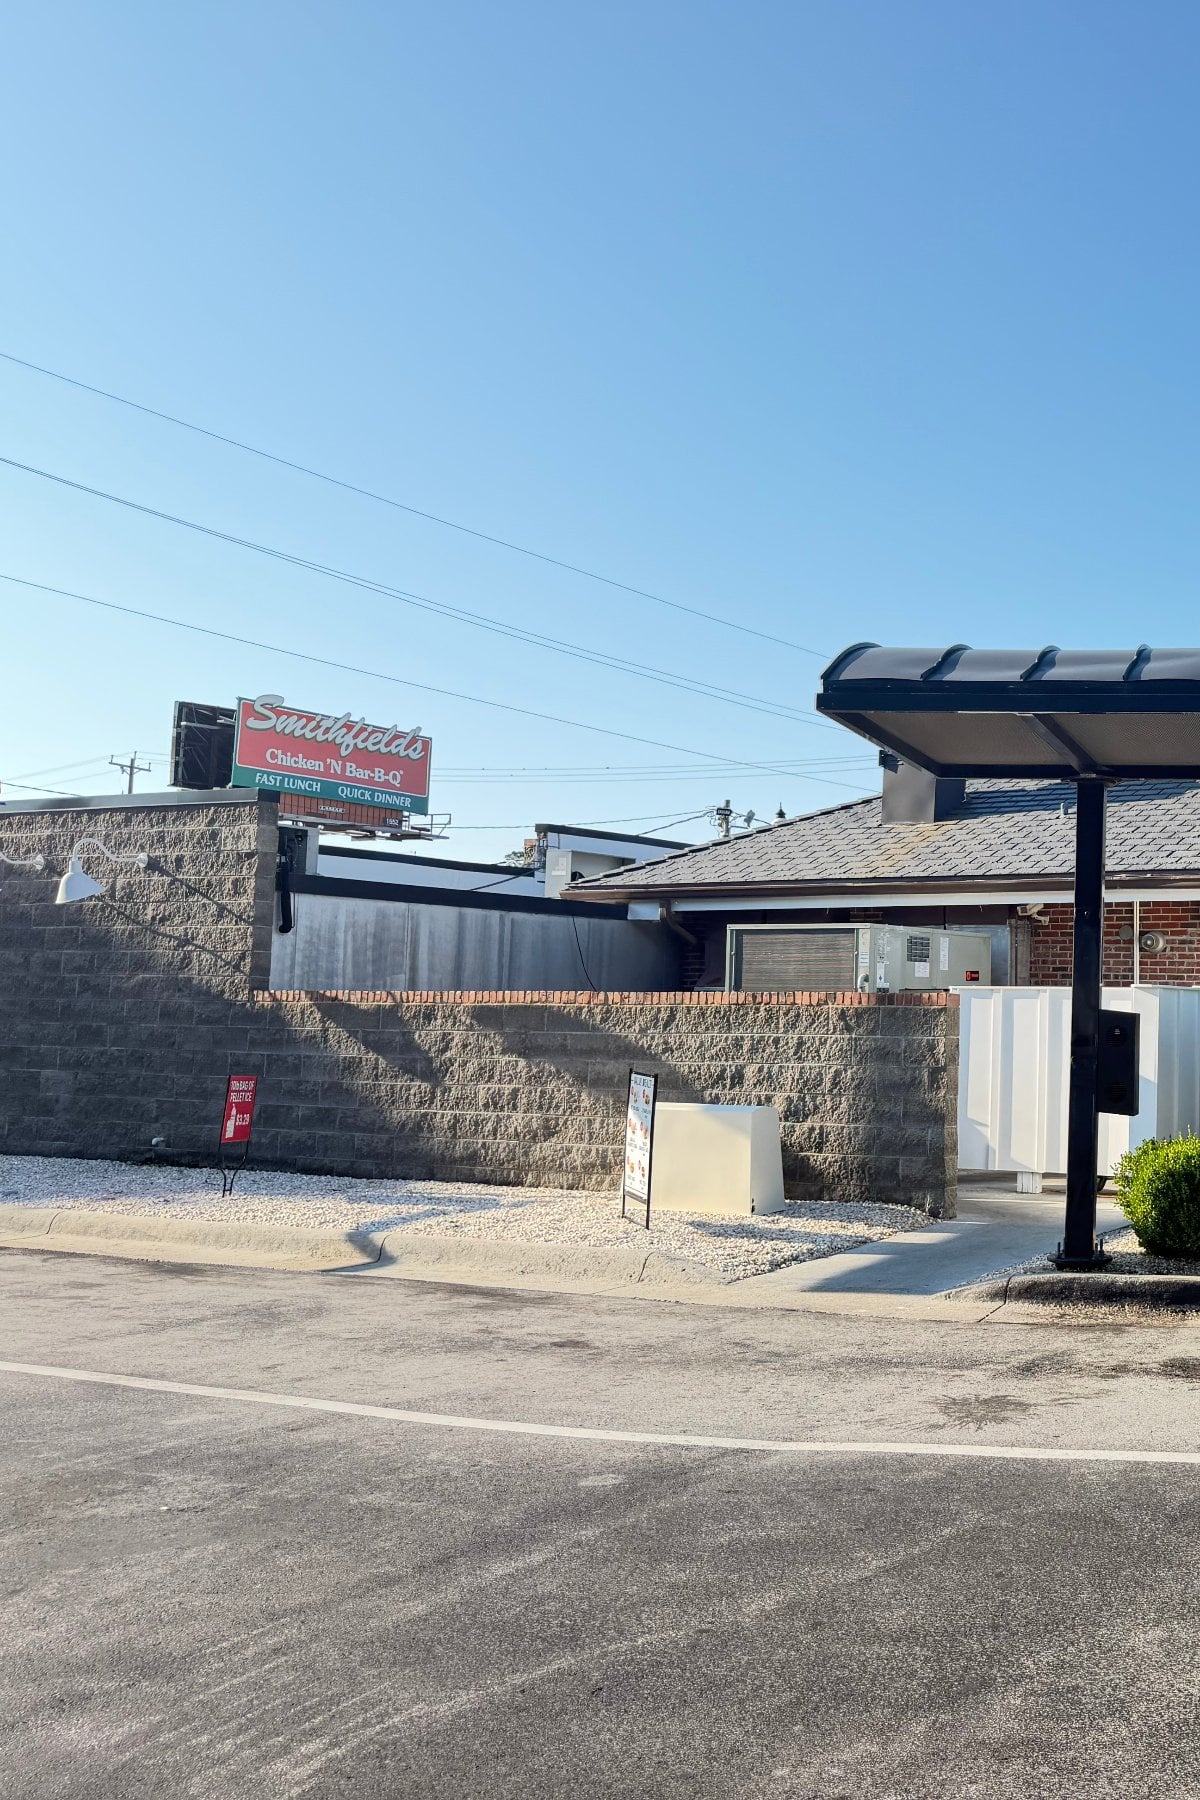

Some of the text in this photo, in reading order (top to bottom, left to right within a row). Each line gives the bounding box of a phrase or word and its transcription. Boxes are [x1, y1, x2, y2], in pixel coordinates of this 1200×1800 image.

[246, 694, 425, 760] Smithfield's
[265, 748, 324, 772] Chicken
[255, 772, 412, 808] FAST LUNCH QUICK DINNER
